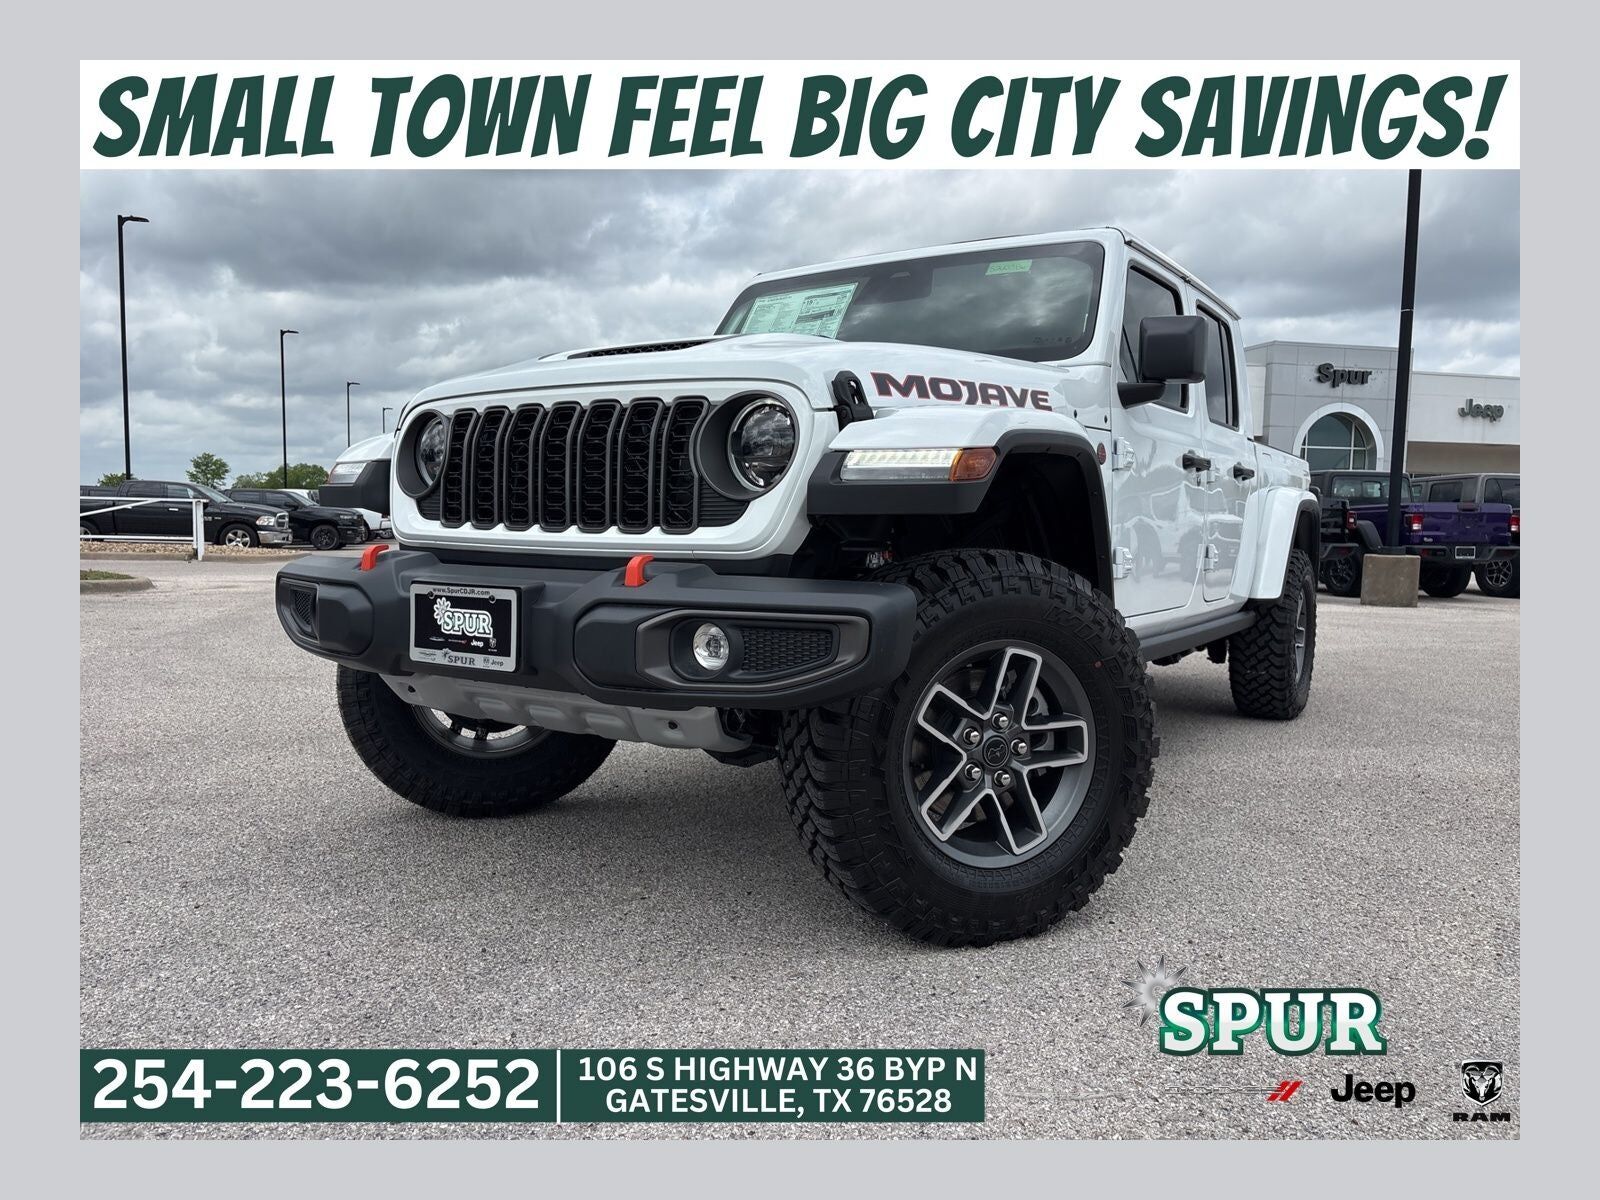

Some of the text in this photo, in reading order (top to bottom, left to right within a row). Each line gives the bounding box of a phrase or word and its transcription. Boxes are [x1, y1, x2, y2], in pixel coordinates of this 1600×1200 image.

[1317, 363, 1372, 387] Spur
[870, 371, 1052, 412] MOJAVE
[1458, 398, 1505, 422] Jeep
[432, 587, 491, 596] www.SpurCDJR.com
[442, 610, 493, 636] SPUR
[470, 639, 484, 648] Jeep
[447, 655, 476, 666] SPUR
[490, 659, 504, 667] Jeep
